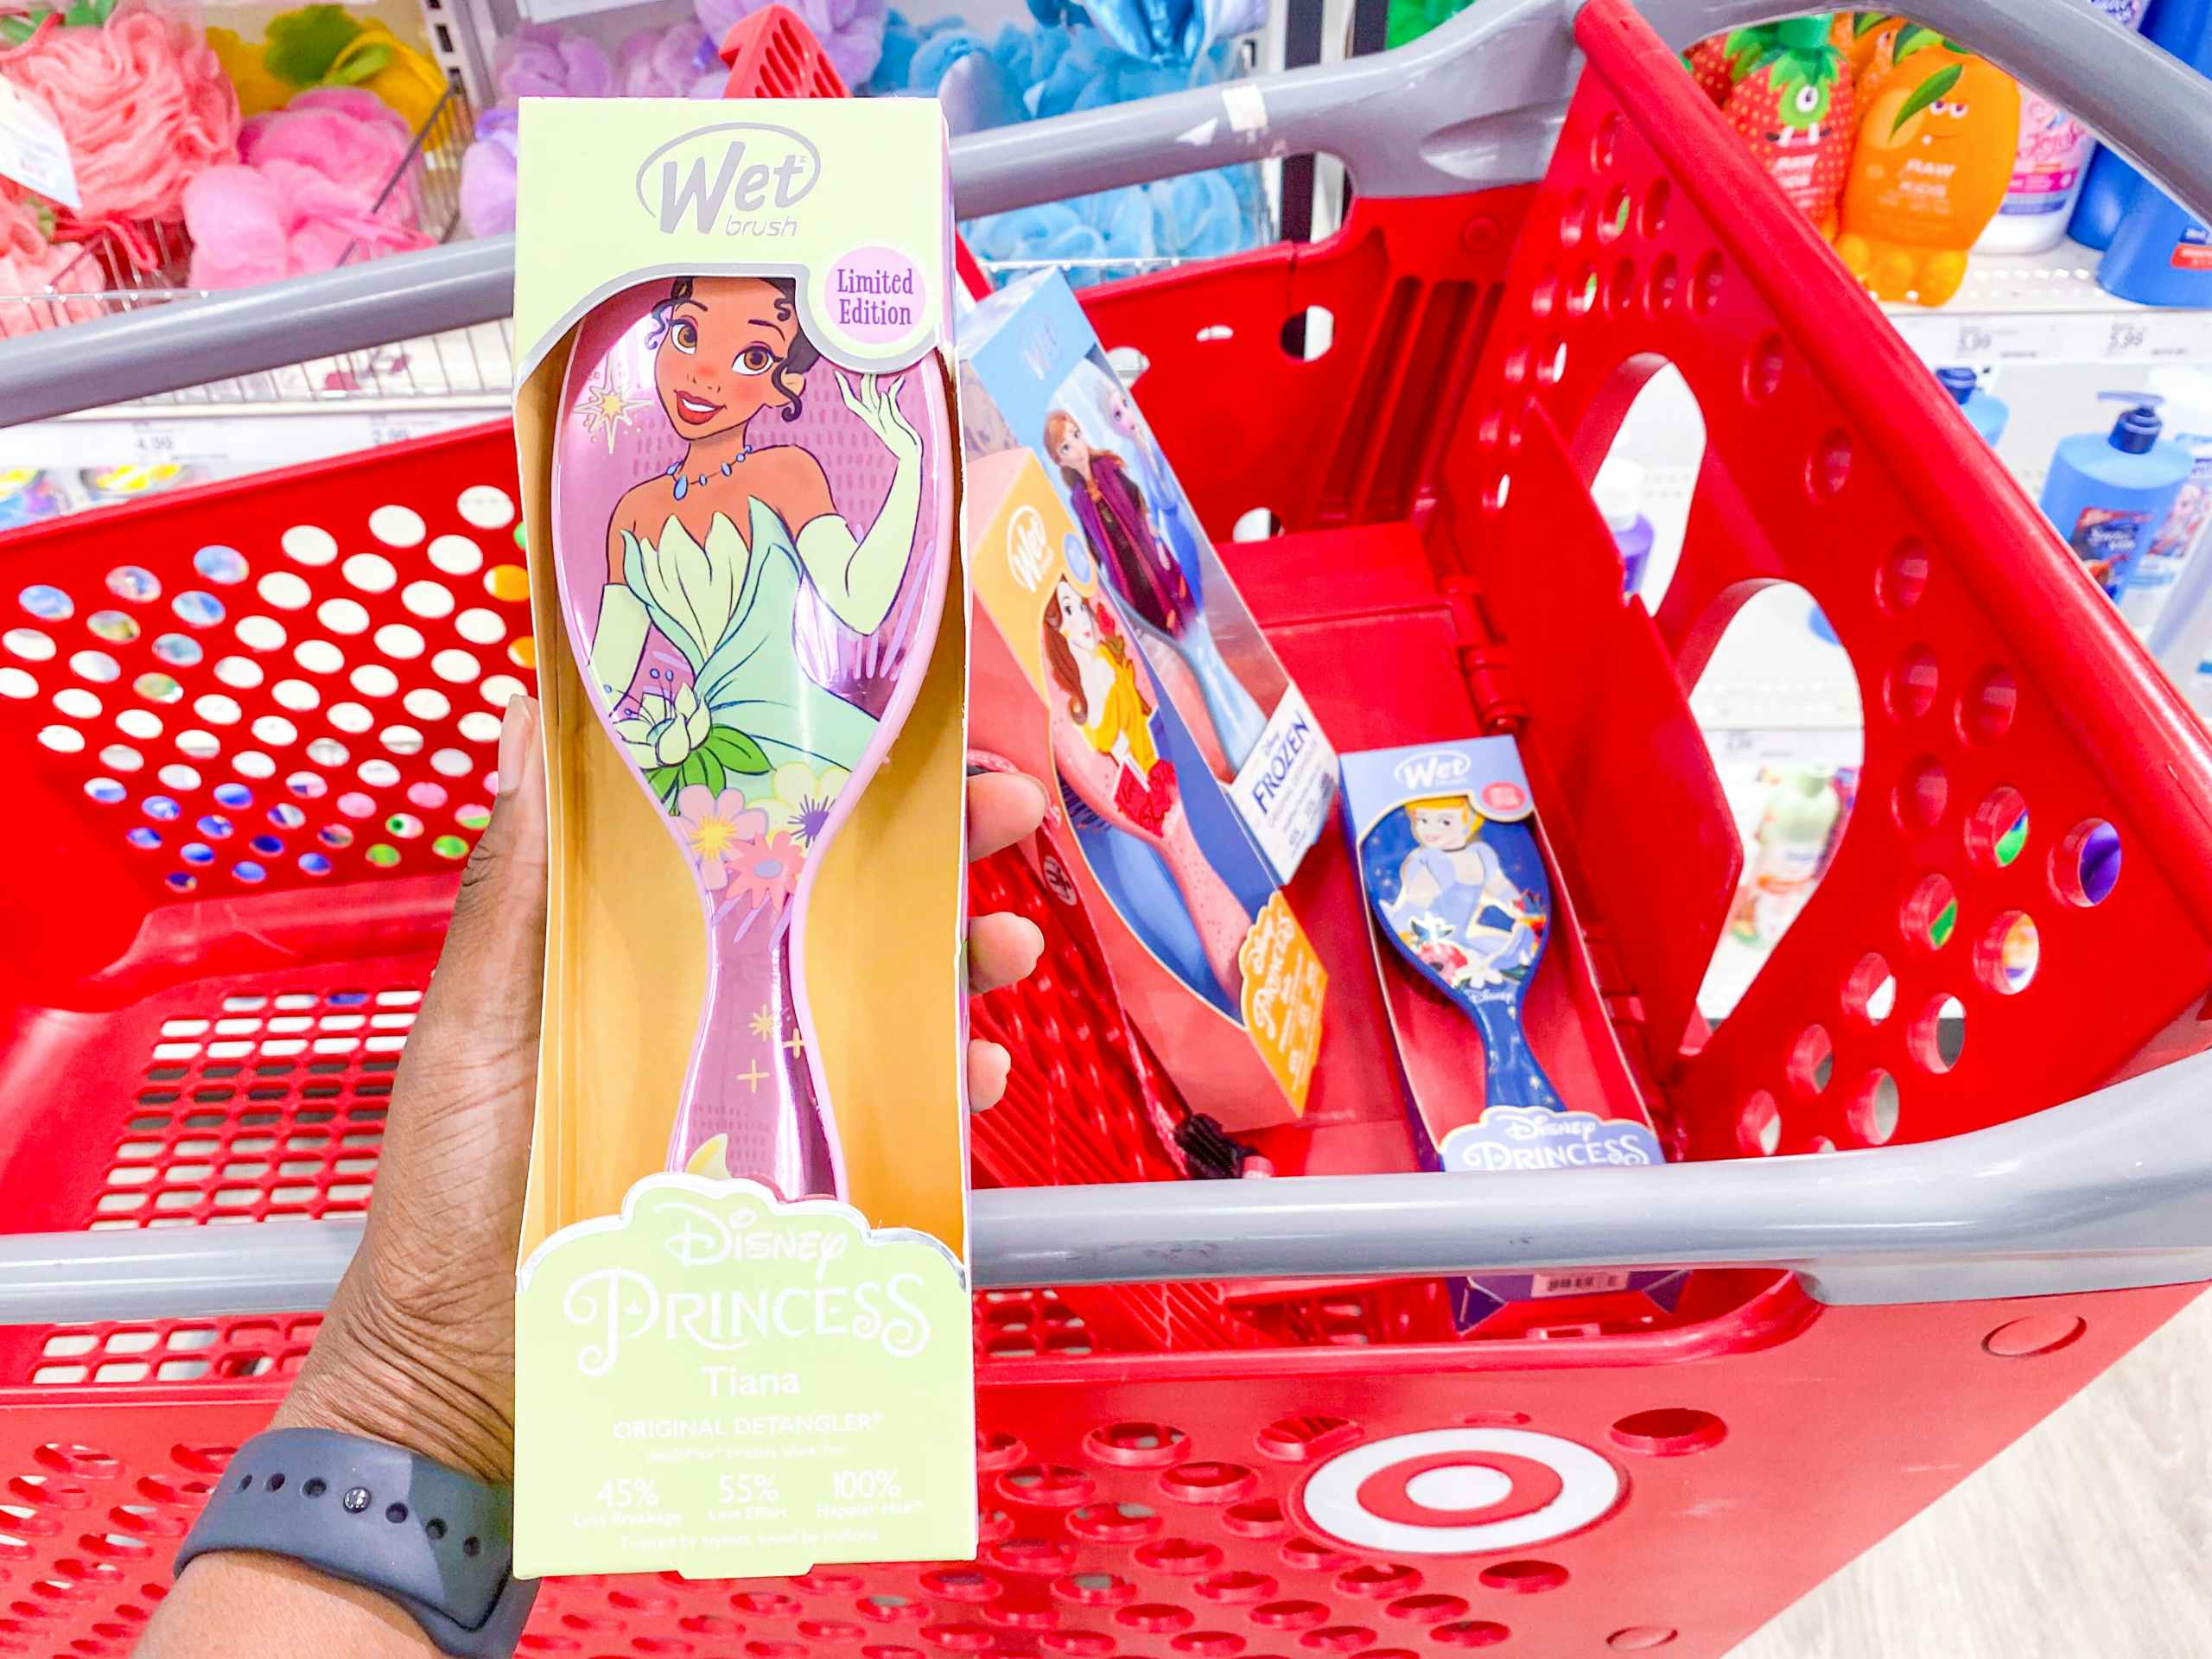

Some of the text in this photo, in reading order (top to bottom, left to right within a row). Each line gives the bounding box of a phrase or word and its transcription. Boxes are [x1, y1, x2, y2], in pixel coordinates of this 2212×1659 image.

[658, 140, 807, 235] Wet
[725, 213, 798, 238] brush
[836, 268, 914, 296] Limited
[838, 298, 912, 326] Edition
[1250, 710, 1311, 815] FROZEN
[1403, 755, 1465, 791] Wet
[563, 1268, 932, 1377] PRINCESS
[697, 1364, 802, 1397] Tiana
[612, 1419, 725, 1440] ORIGINAL
[594, 1478, 660, 1508] 45%
[718, 1472, 781, 1503] 55%
[833, 1469, 901, 1499] 100%
